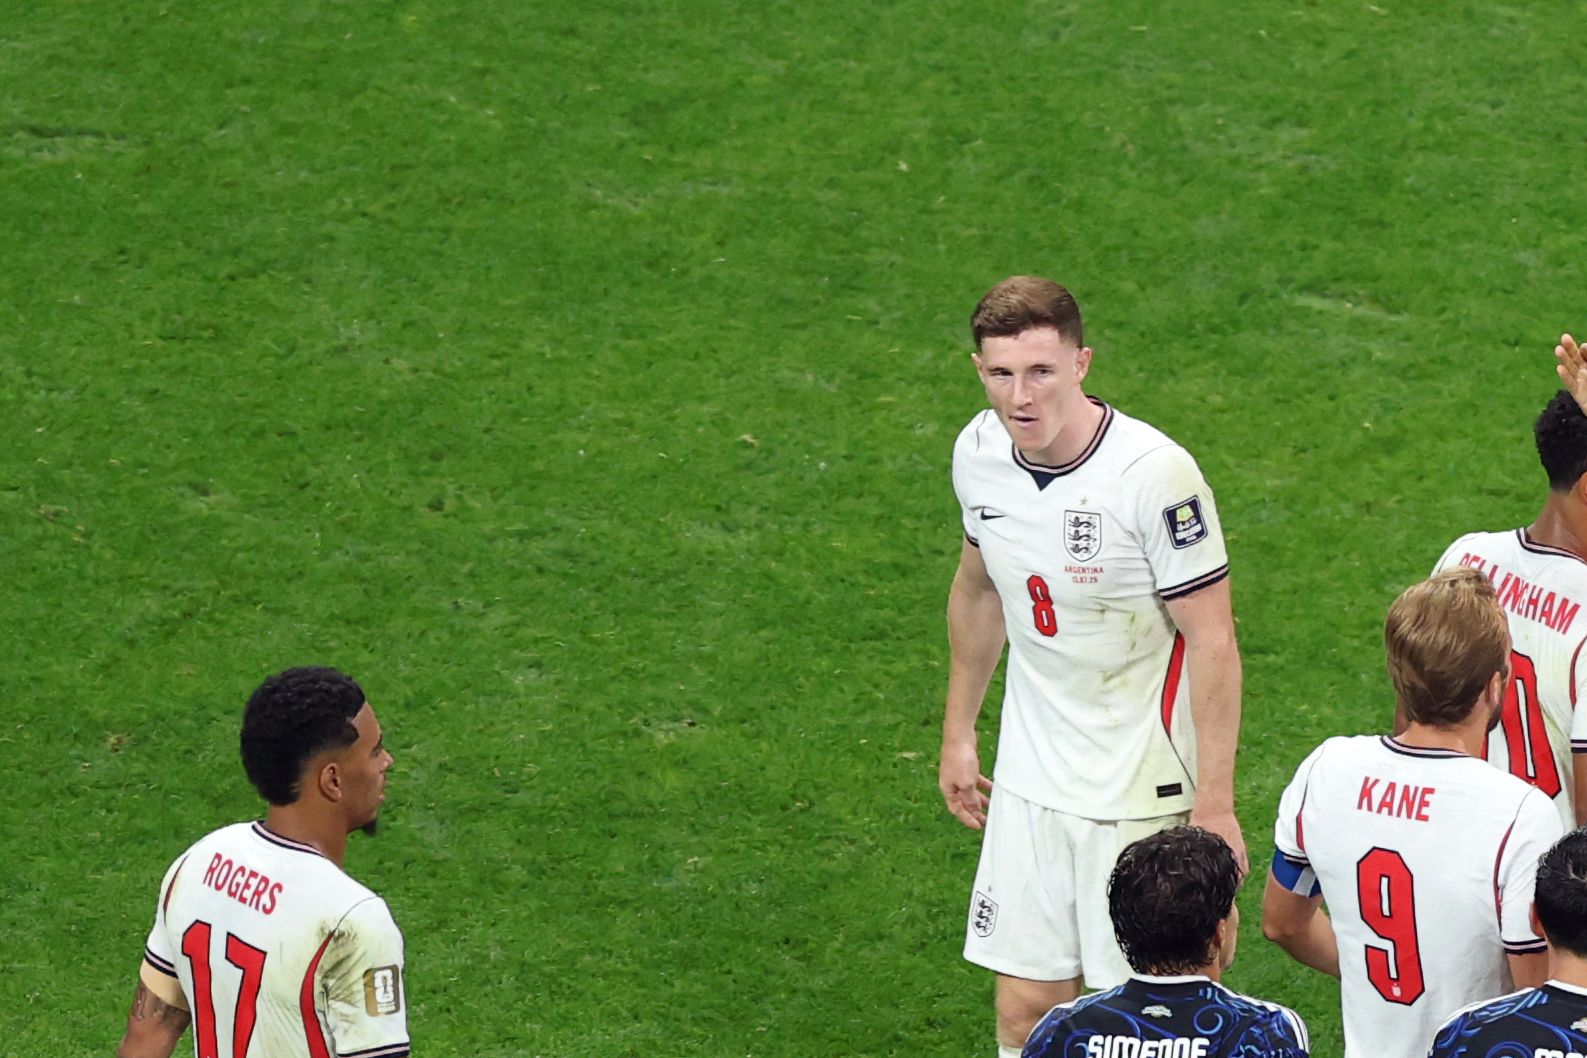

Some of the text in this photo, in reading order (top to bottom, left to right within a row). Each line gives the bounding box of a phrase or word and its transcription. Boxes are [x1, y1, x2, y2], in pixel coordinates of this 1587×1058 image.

[1026, 574, 1058, 637] 8
[1357, 776, 1436, 823] KANE
[203, 851, 284, 916] ROGERS
[1356, 846, 1426, 1006] 9
